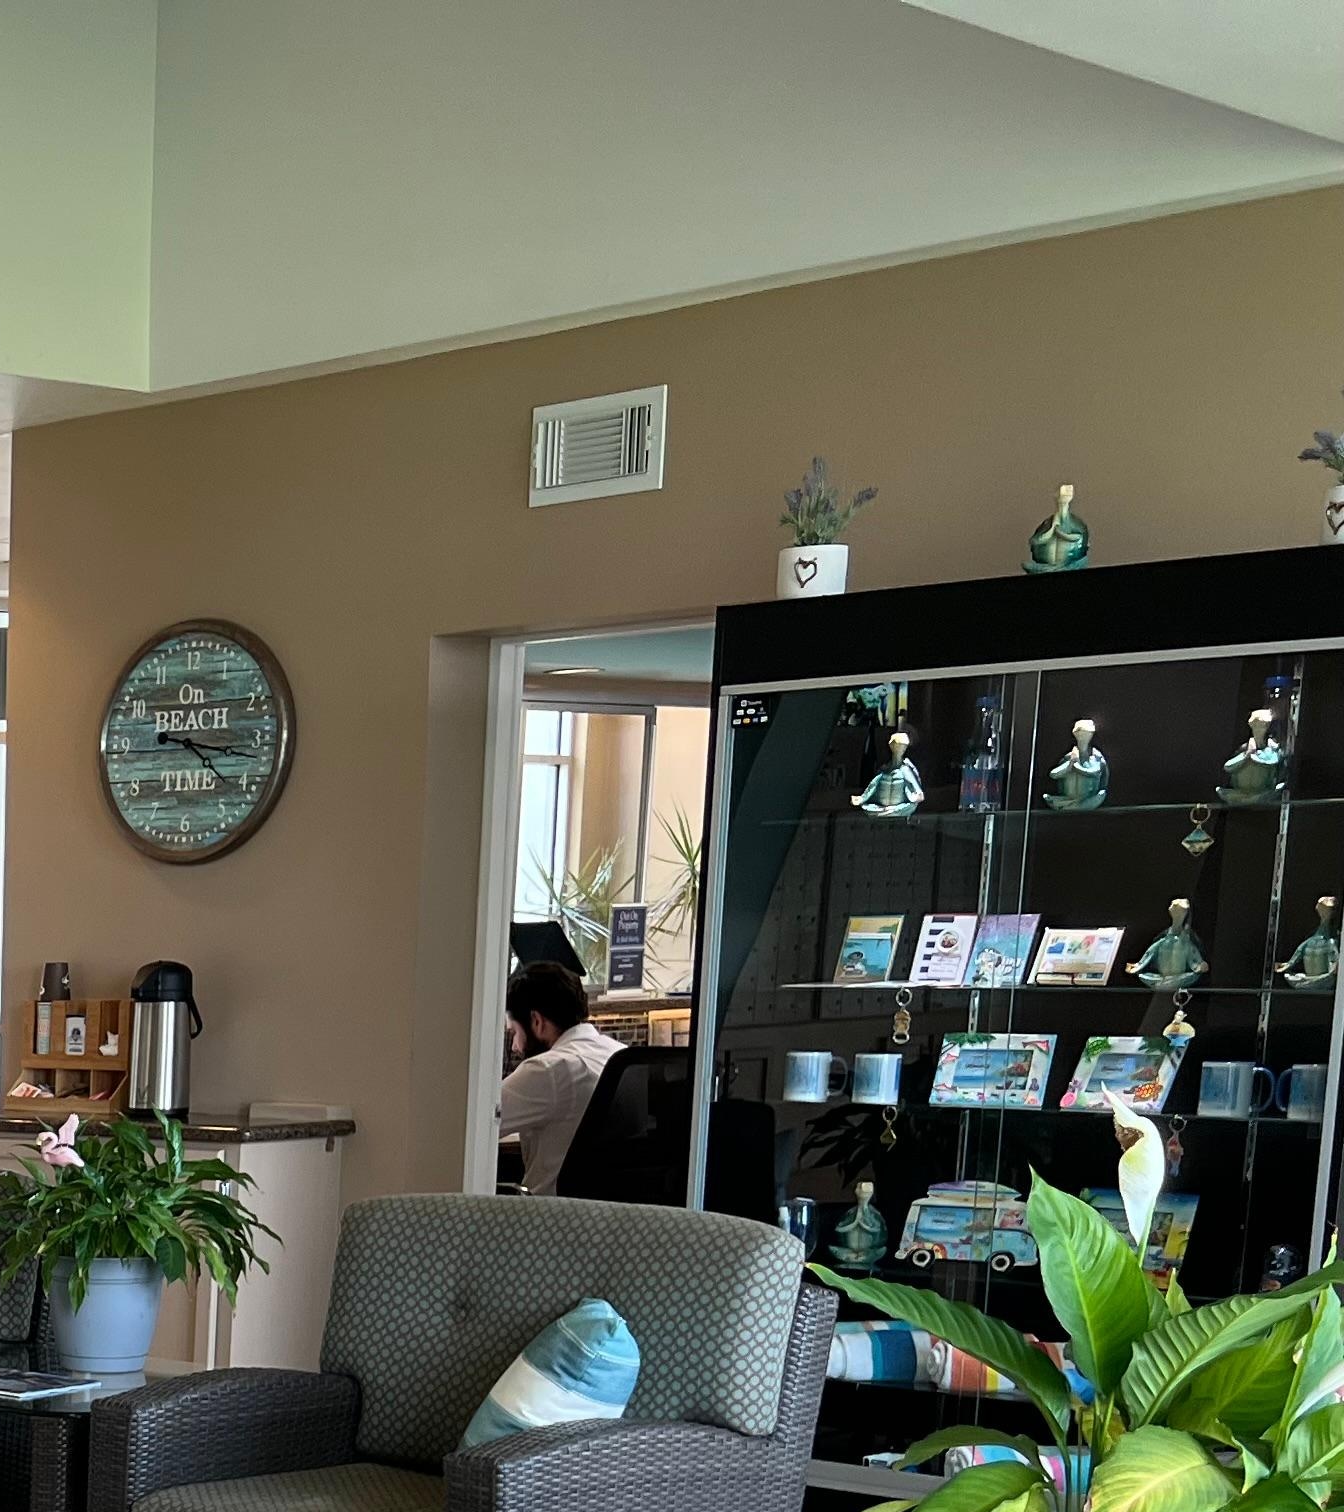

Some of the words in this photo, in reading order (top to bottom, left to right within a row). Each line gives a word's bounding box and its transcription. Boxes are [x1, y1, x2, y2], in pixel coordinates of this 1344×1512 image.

[187, 651, 201, 670] 12
[156, 666, 167, 685] 11
[222, 661, 227, 680] 1
[179, 684, 205, 703] On
[246, 692, 255, 711] 2
[132, 699, 146, 719] 10
[154, 707, 229, 732] BEACH
[121, 737, 130, 756] 9
[251, 730, 261, 748] 3
[129, 778, 140, 796] 8
[161, 769, 216, 792] TIME
[238, 772, 248, 791] 4
[150, 802, 160, 820] 7
[217, 799, 225, 818] 5
[180, 813, 190, 832] 6
